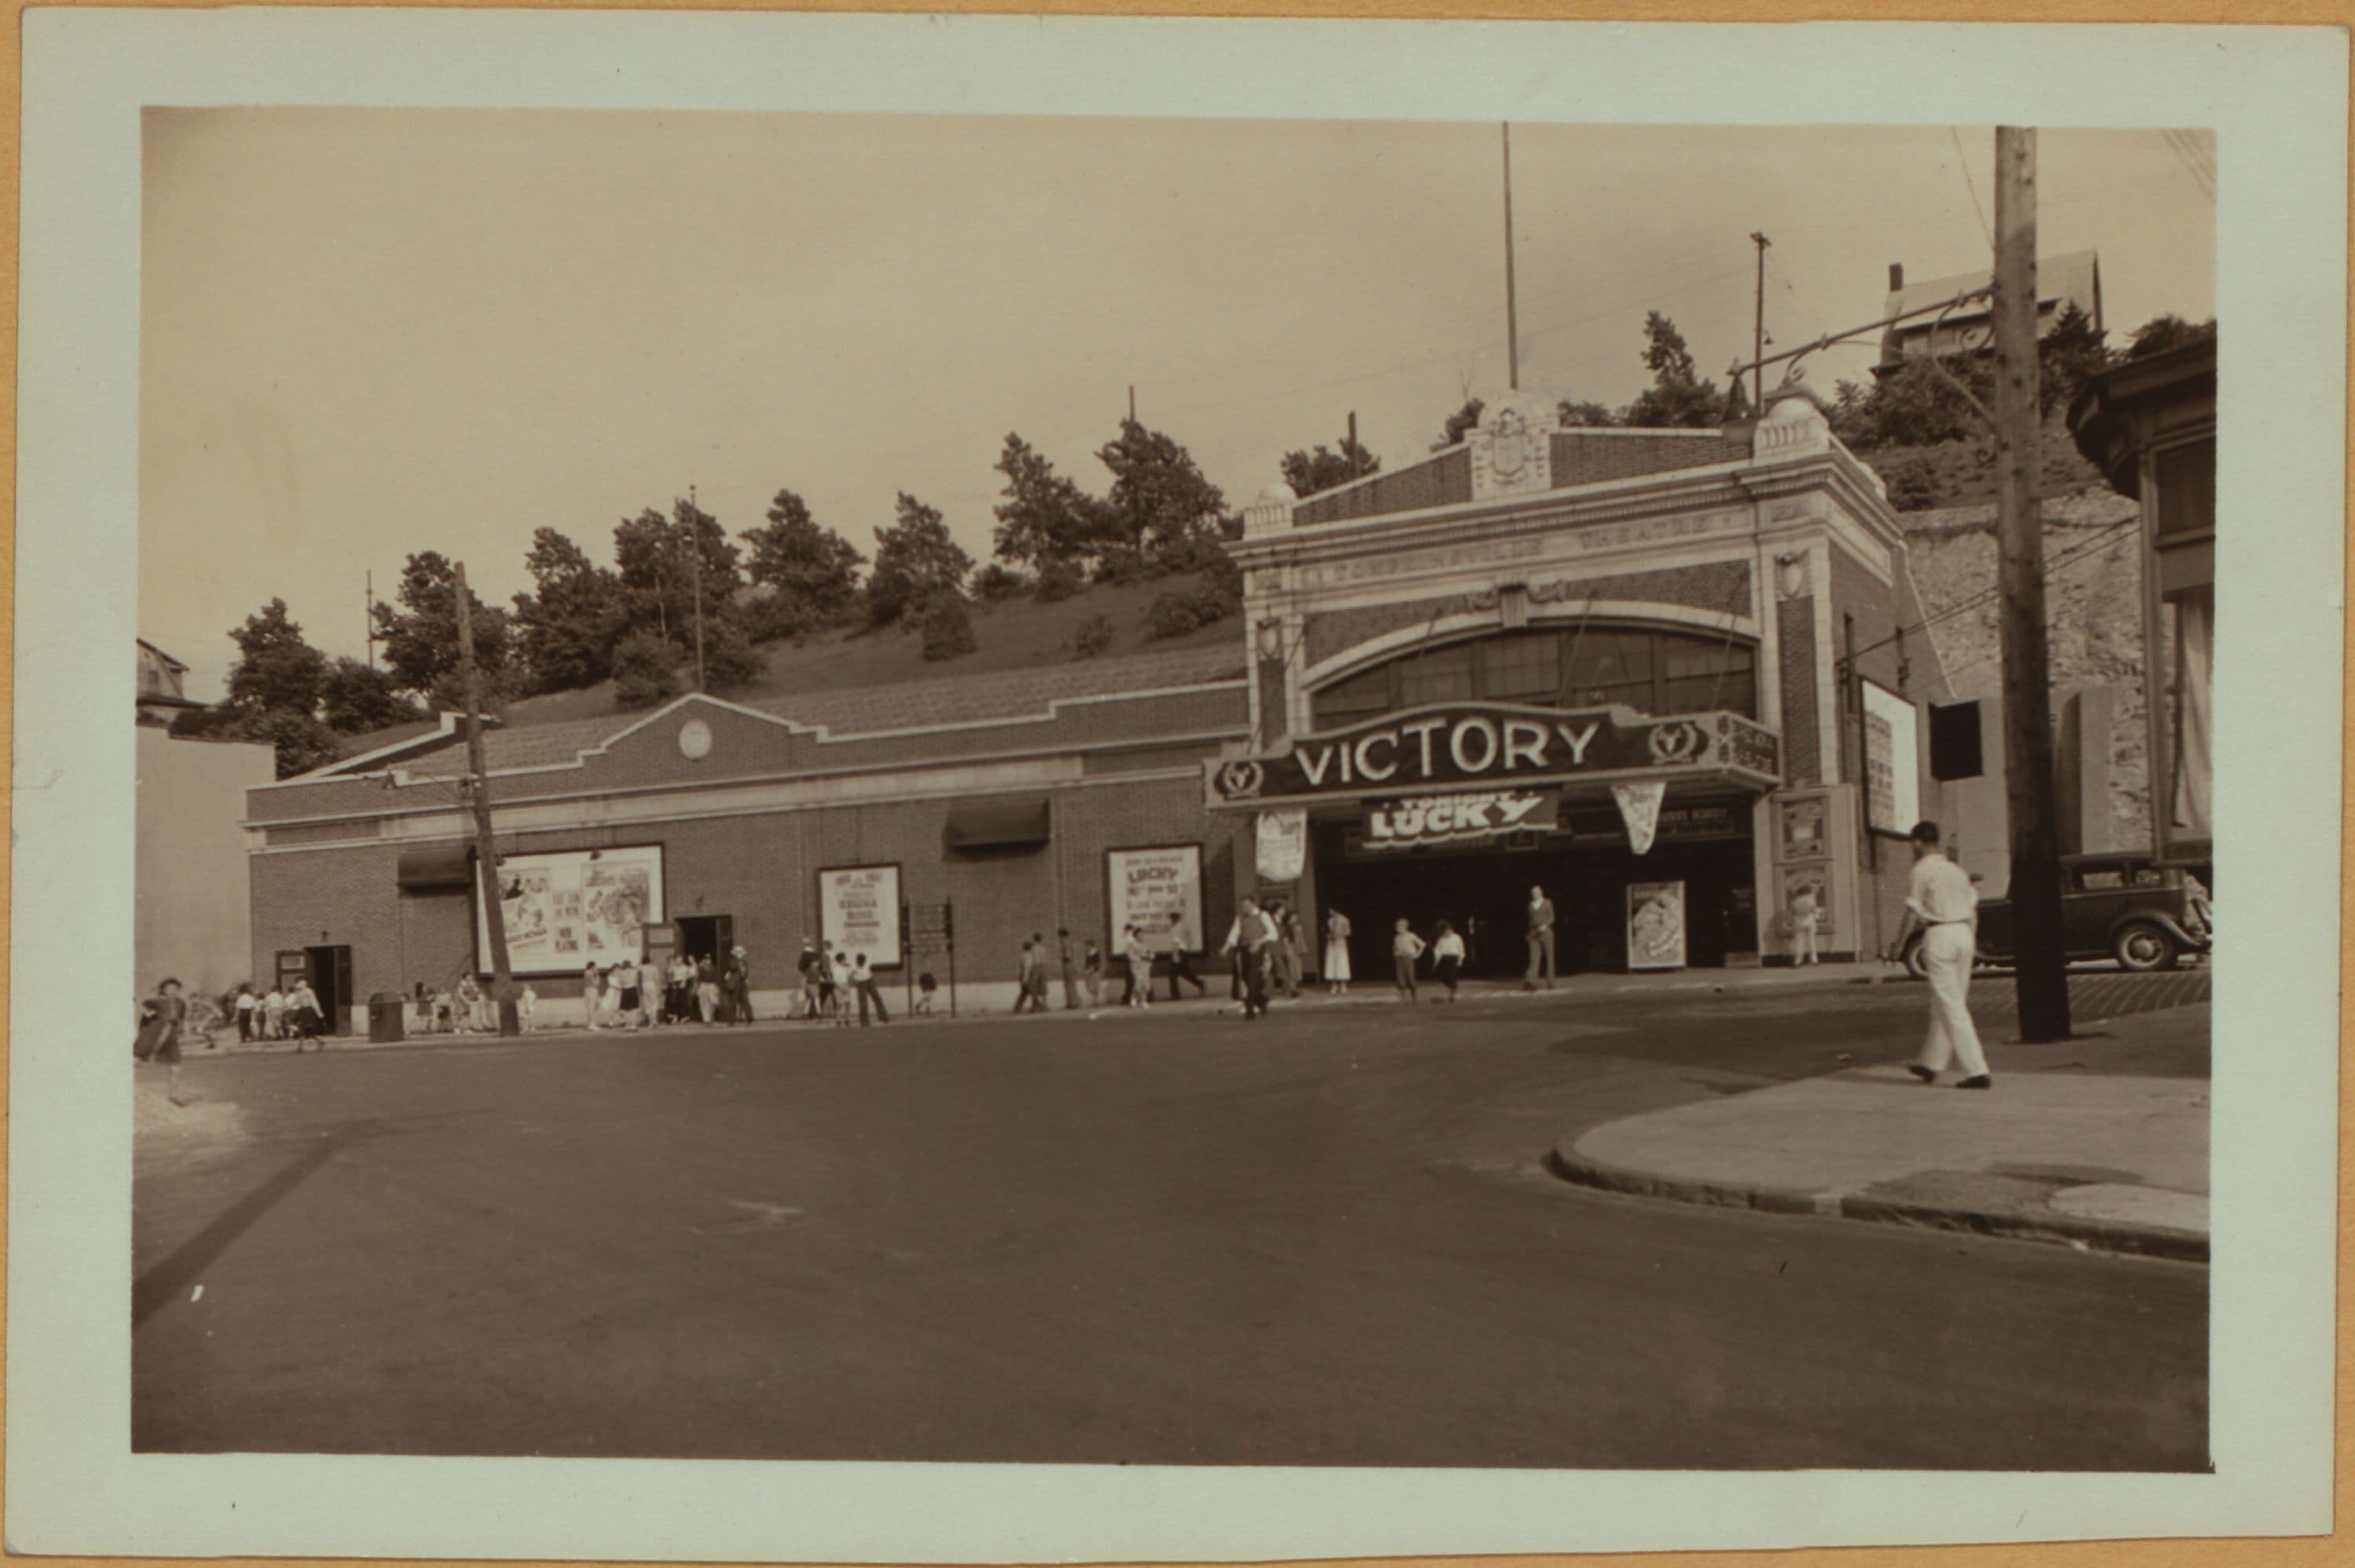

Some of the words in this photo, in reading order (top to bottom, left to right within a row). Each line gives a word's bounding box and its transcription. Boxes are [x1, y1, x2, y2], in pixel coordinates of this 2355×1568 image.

[1294, 717, 1601, 786] VICTORY
[1400, 791, 1517, 809] TONIGHT
[1370, 796, 1544, 837] LUCKY
[1128, 866, 1179, 884] LUCKY
